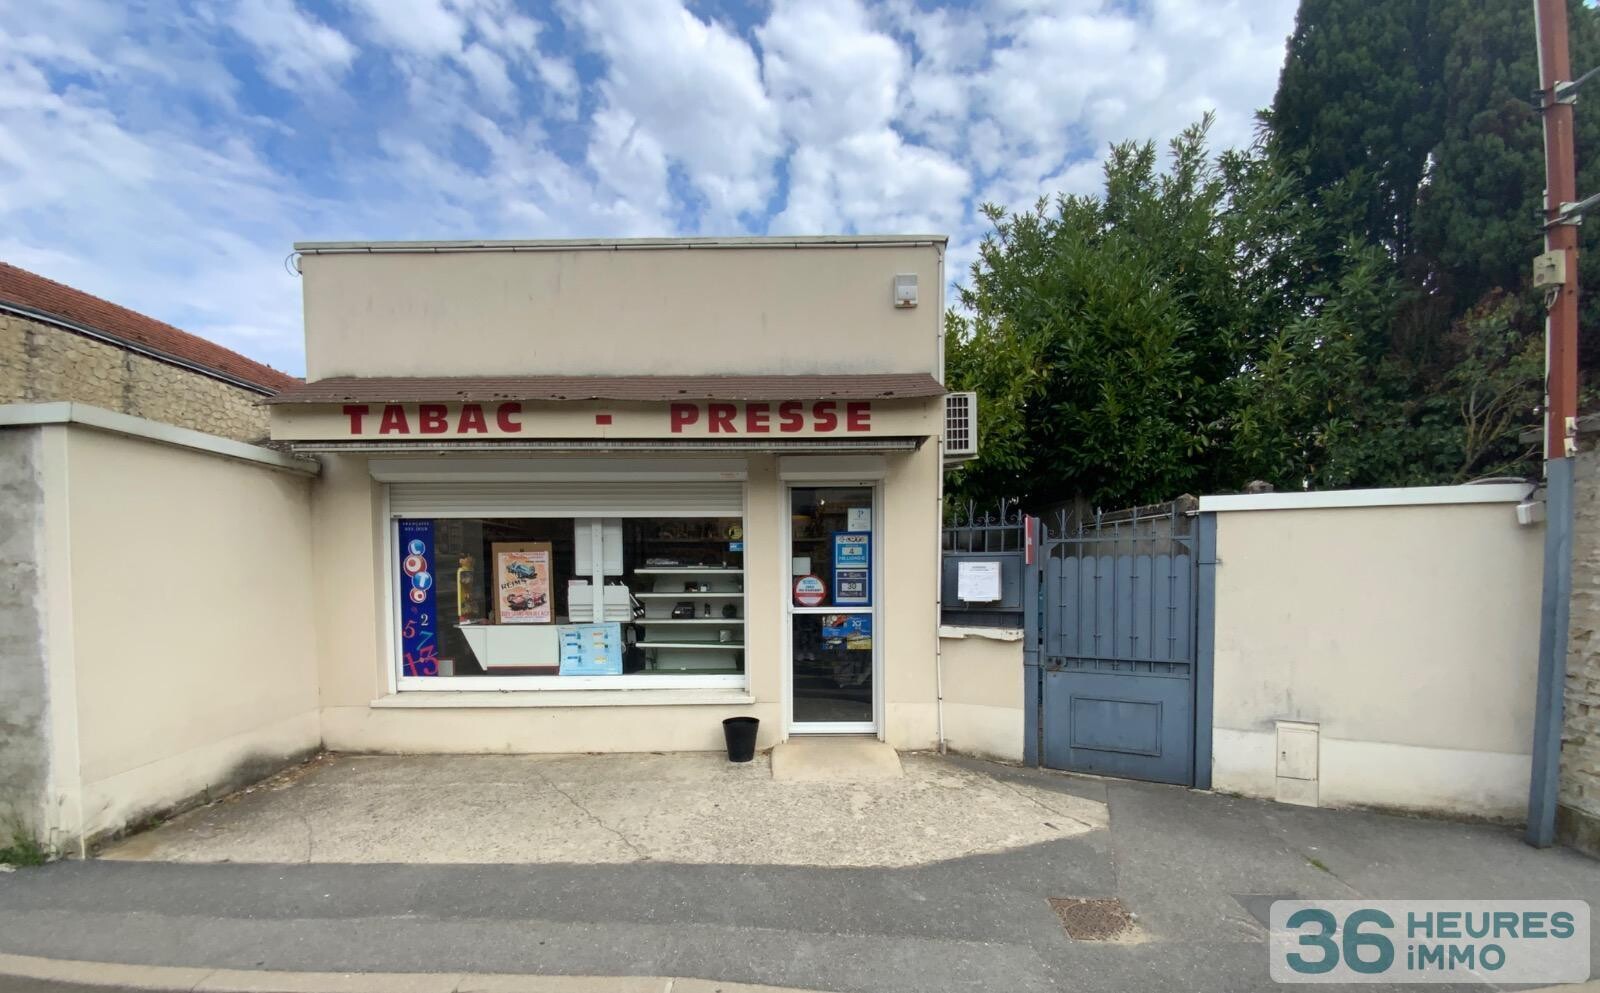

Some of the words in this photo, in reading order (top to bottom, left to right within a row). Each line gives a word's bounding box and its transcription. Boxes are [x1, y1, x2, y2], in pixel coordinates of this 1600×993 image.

[342, 402, 522, 434] TABAC
[595, 414, 612, 425] -
[670, 401, 872, 433] PRESSE
[420, 613, 429, 626] 2
[403, 620, 417, 638] 5
